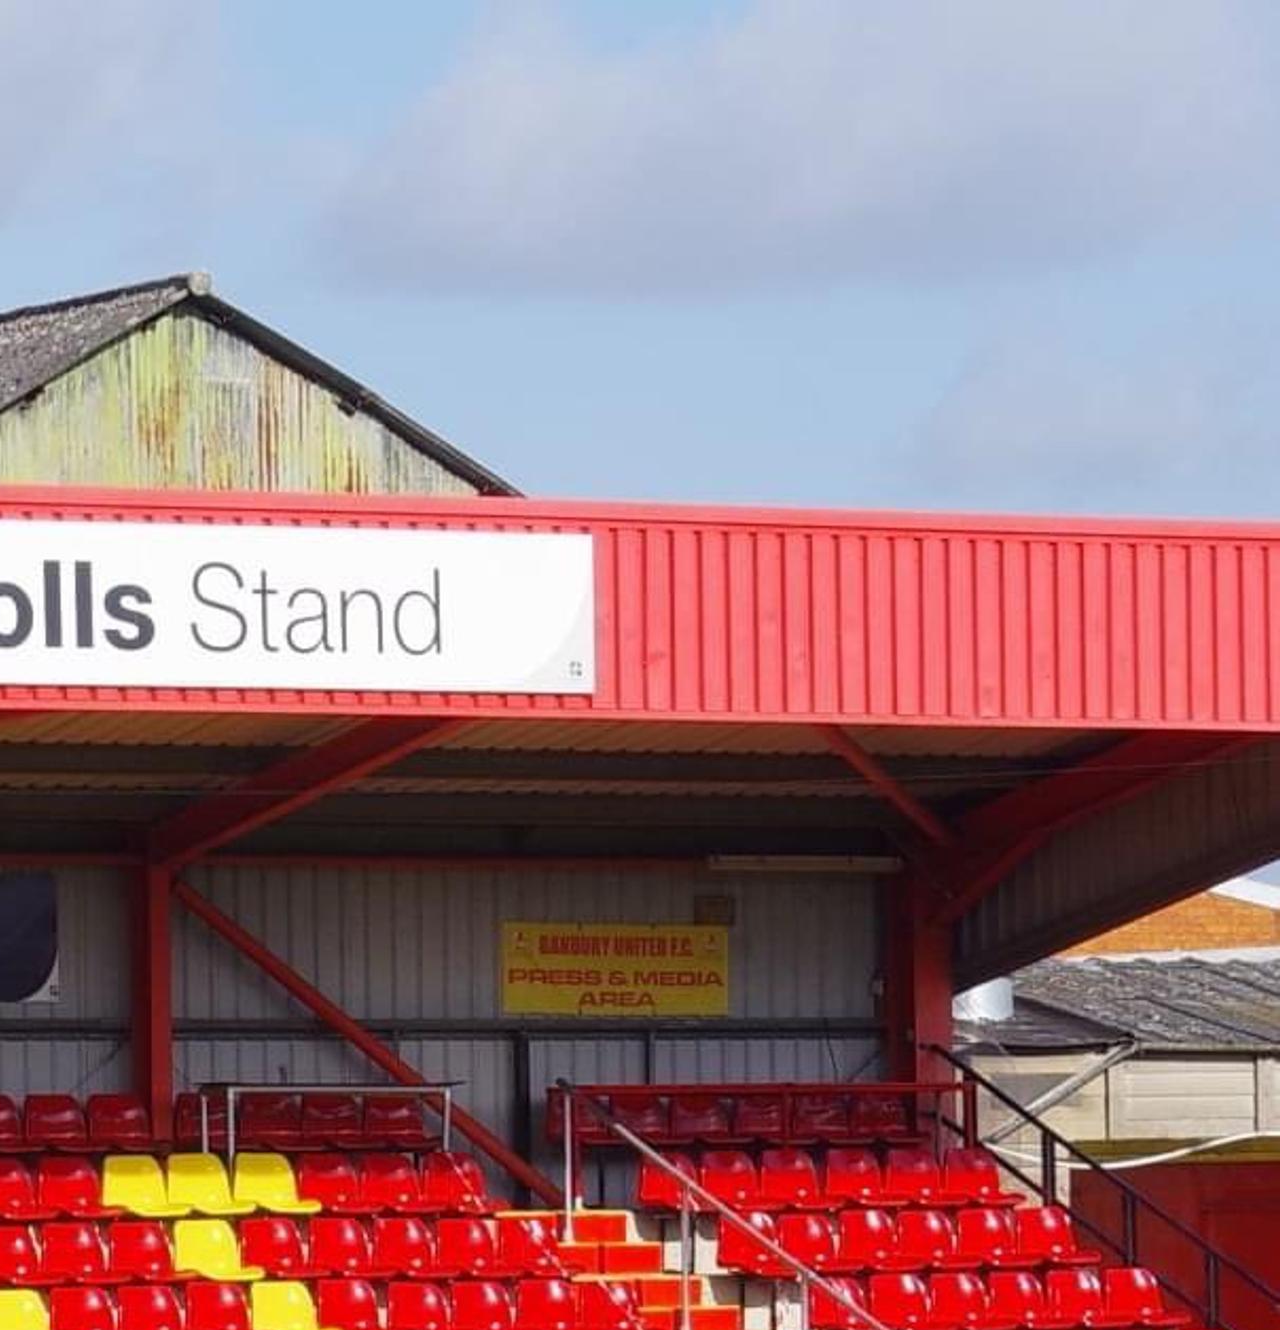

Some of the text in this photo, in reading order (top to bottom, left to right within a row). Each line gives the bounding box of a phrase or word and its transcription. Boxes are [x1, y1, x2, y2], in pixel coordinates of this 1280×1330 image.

[191, 562, 441, 656] Stand
[508, 968, 724, 987] PRESS & MEDIA
[579, 991, 655, 1008] AREA
